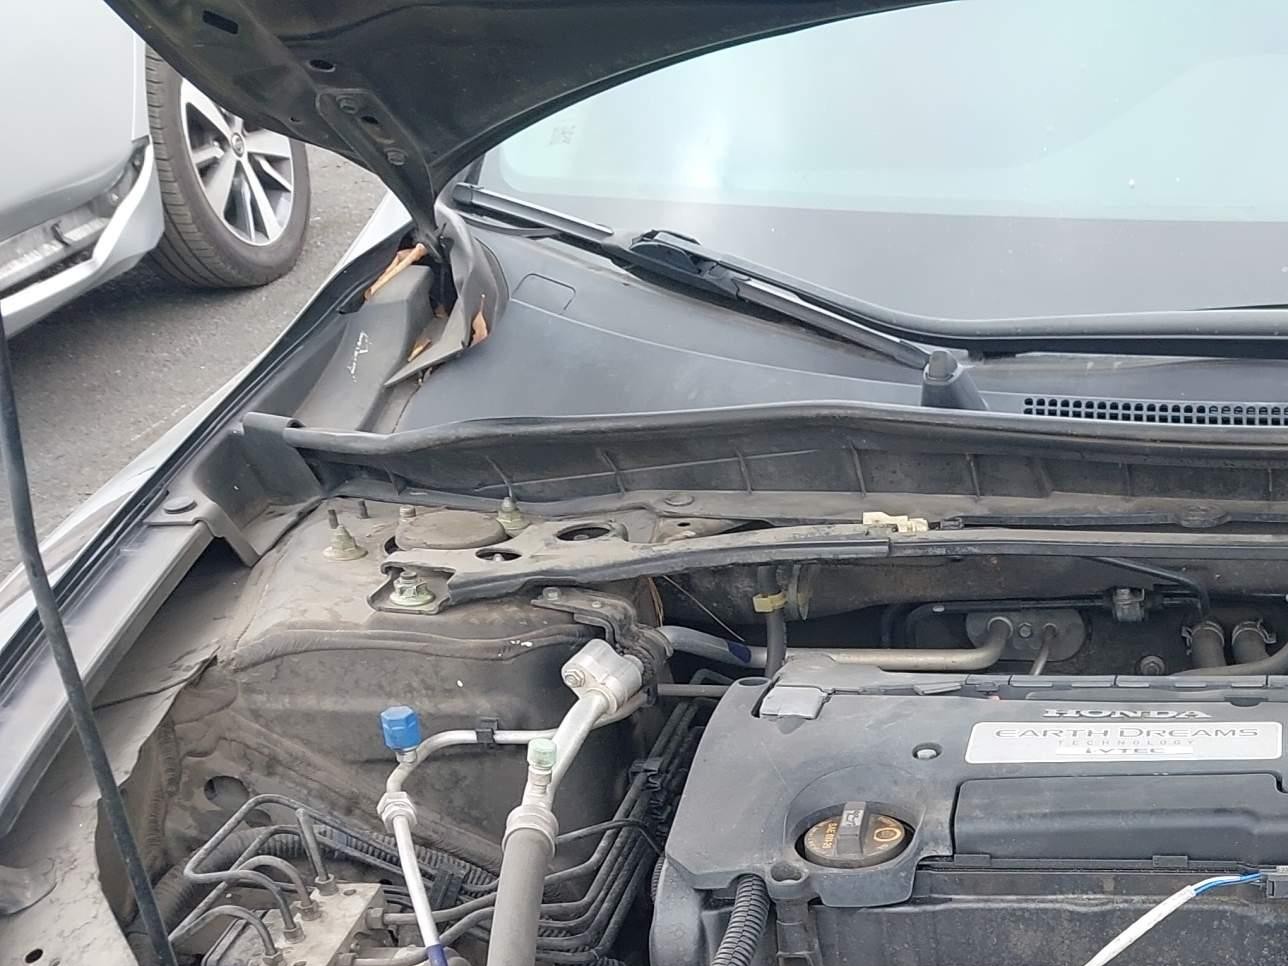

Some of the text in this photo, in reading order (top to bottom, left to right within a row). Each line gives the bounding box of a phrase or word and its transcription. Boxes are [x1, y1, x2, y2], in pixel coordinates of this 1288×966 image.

[1042, 707, 1213, 719] HONDA
[995, 727, 1259, 738] EARTH DREAMS
